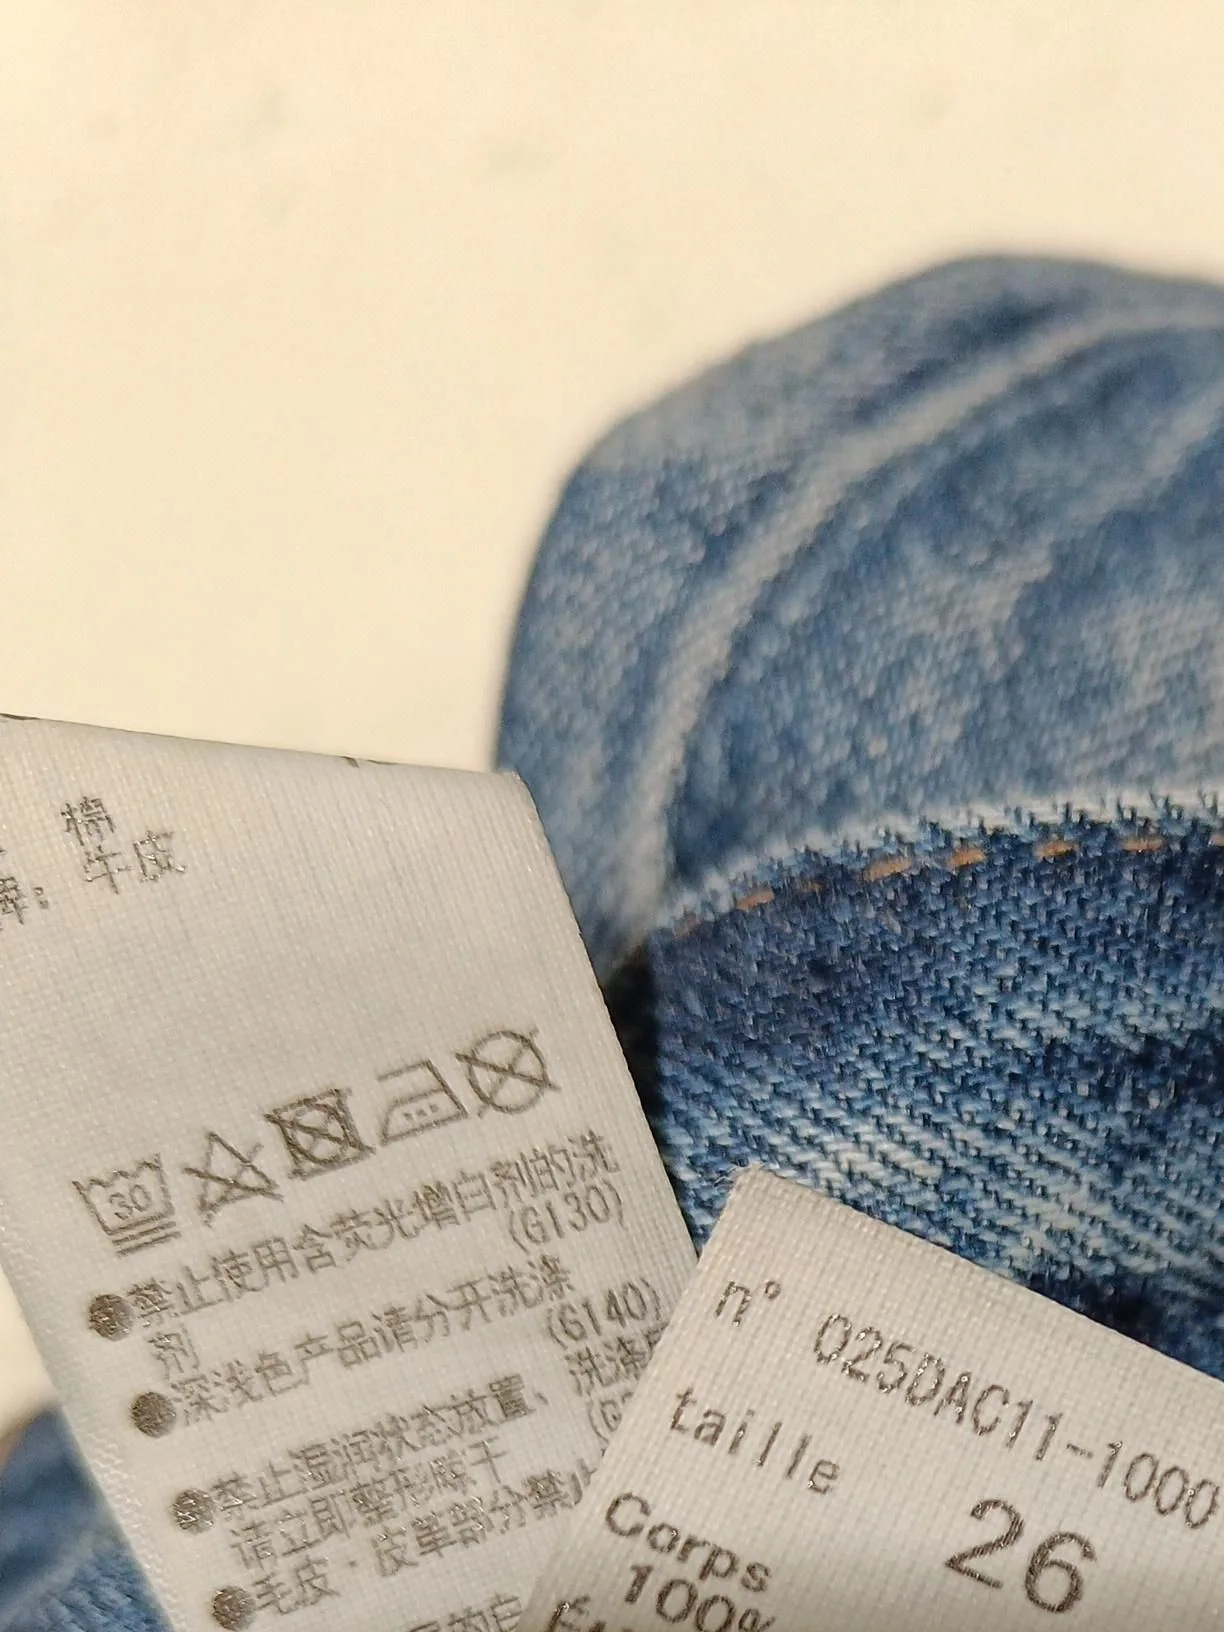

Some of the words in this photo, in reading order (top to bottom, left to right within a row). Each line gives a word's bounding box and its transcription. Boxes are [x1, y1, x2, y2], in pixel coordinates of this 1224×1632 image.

[84, 828, 187, 895] 牛皮
[507, 1180, 625, 1255] (G130)
[545, 1278, 662, 1349] (G140)
[813, 1313, 1220, 1529] 025DAC11-1000
[605, 1493, 772, 1592] Corps
[670, 1388, 841, 1495] taille
[945, 1499, 1096, 1613] 26
